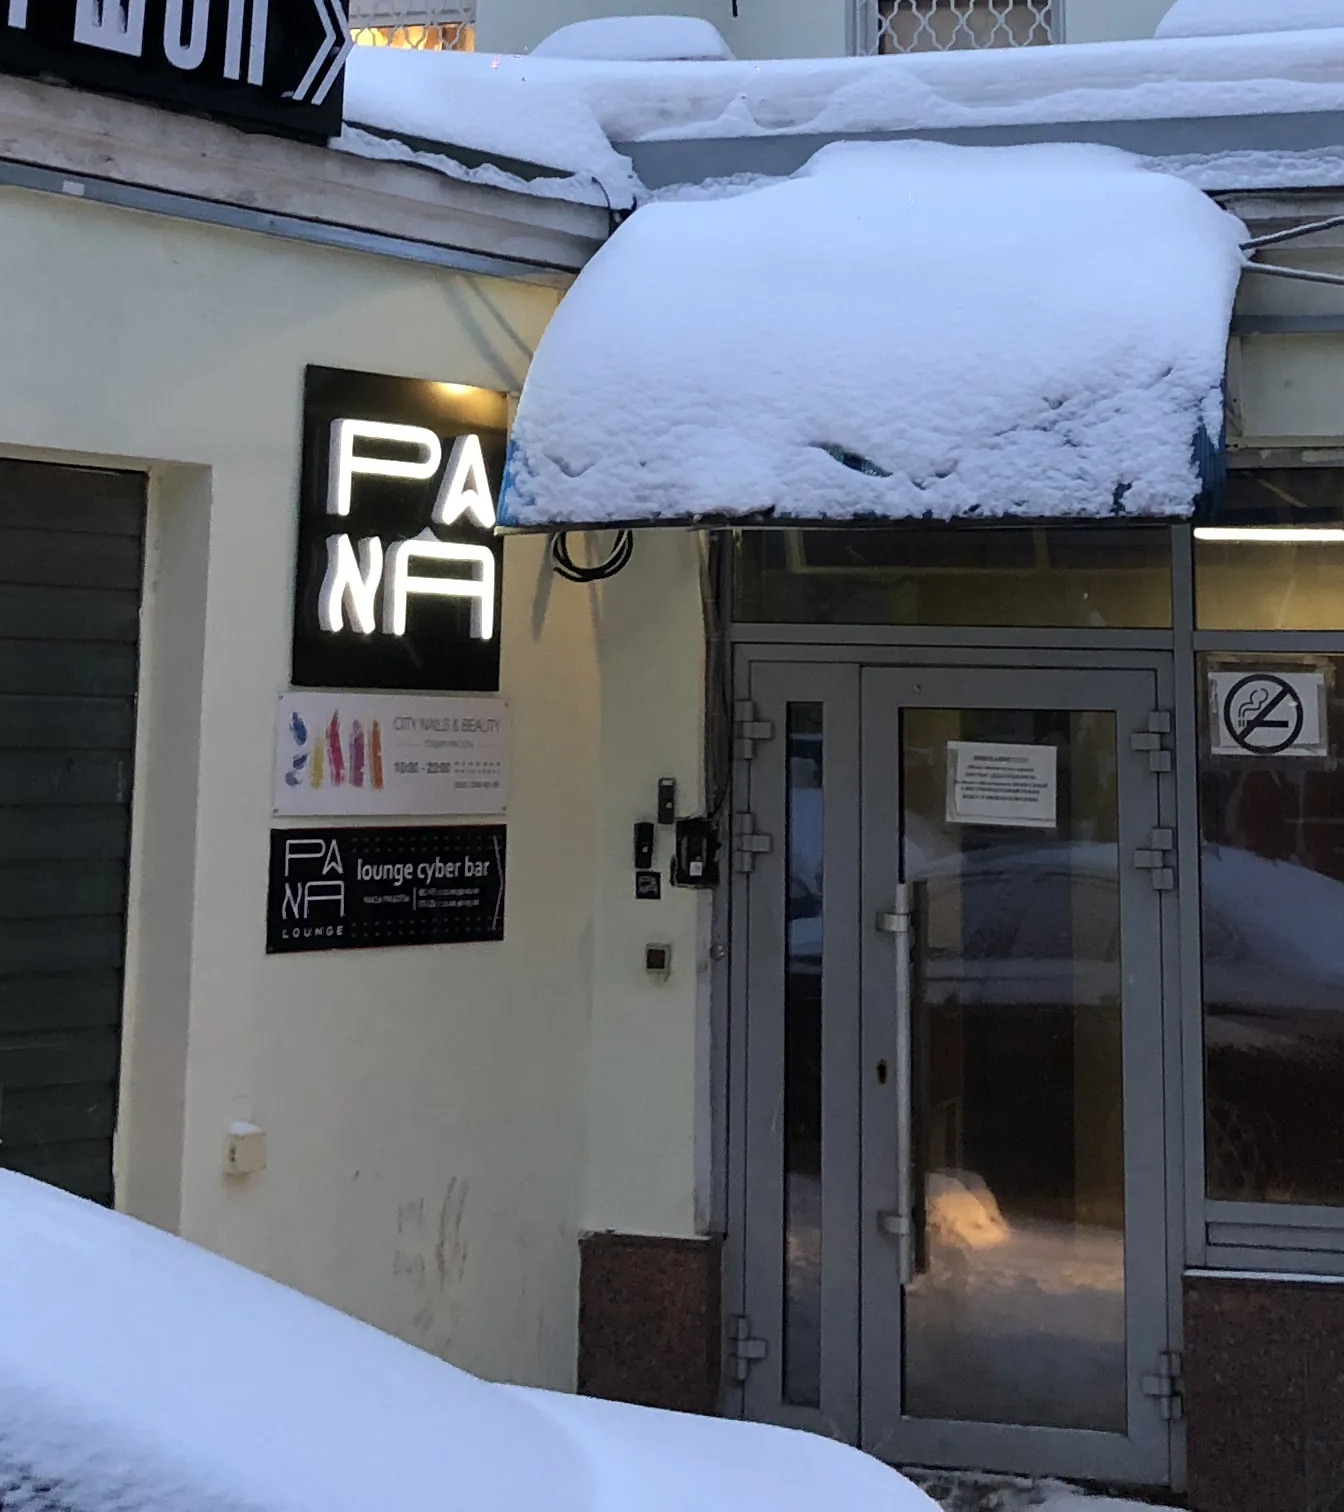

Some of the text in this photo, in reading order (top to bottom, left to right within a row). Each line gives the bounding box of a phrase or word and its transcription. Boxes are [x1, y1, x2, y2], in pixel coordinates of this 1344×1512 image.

[461, 718, 501, 734] BEAUTY
[357, 855, 490, 886] lounge cyber bar
[282, 925, 344, 938] LOUNGE
